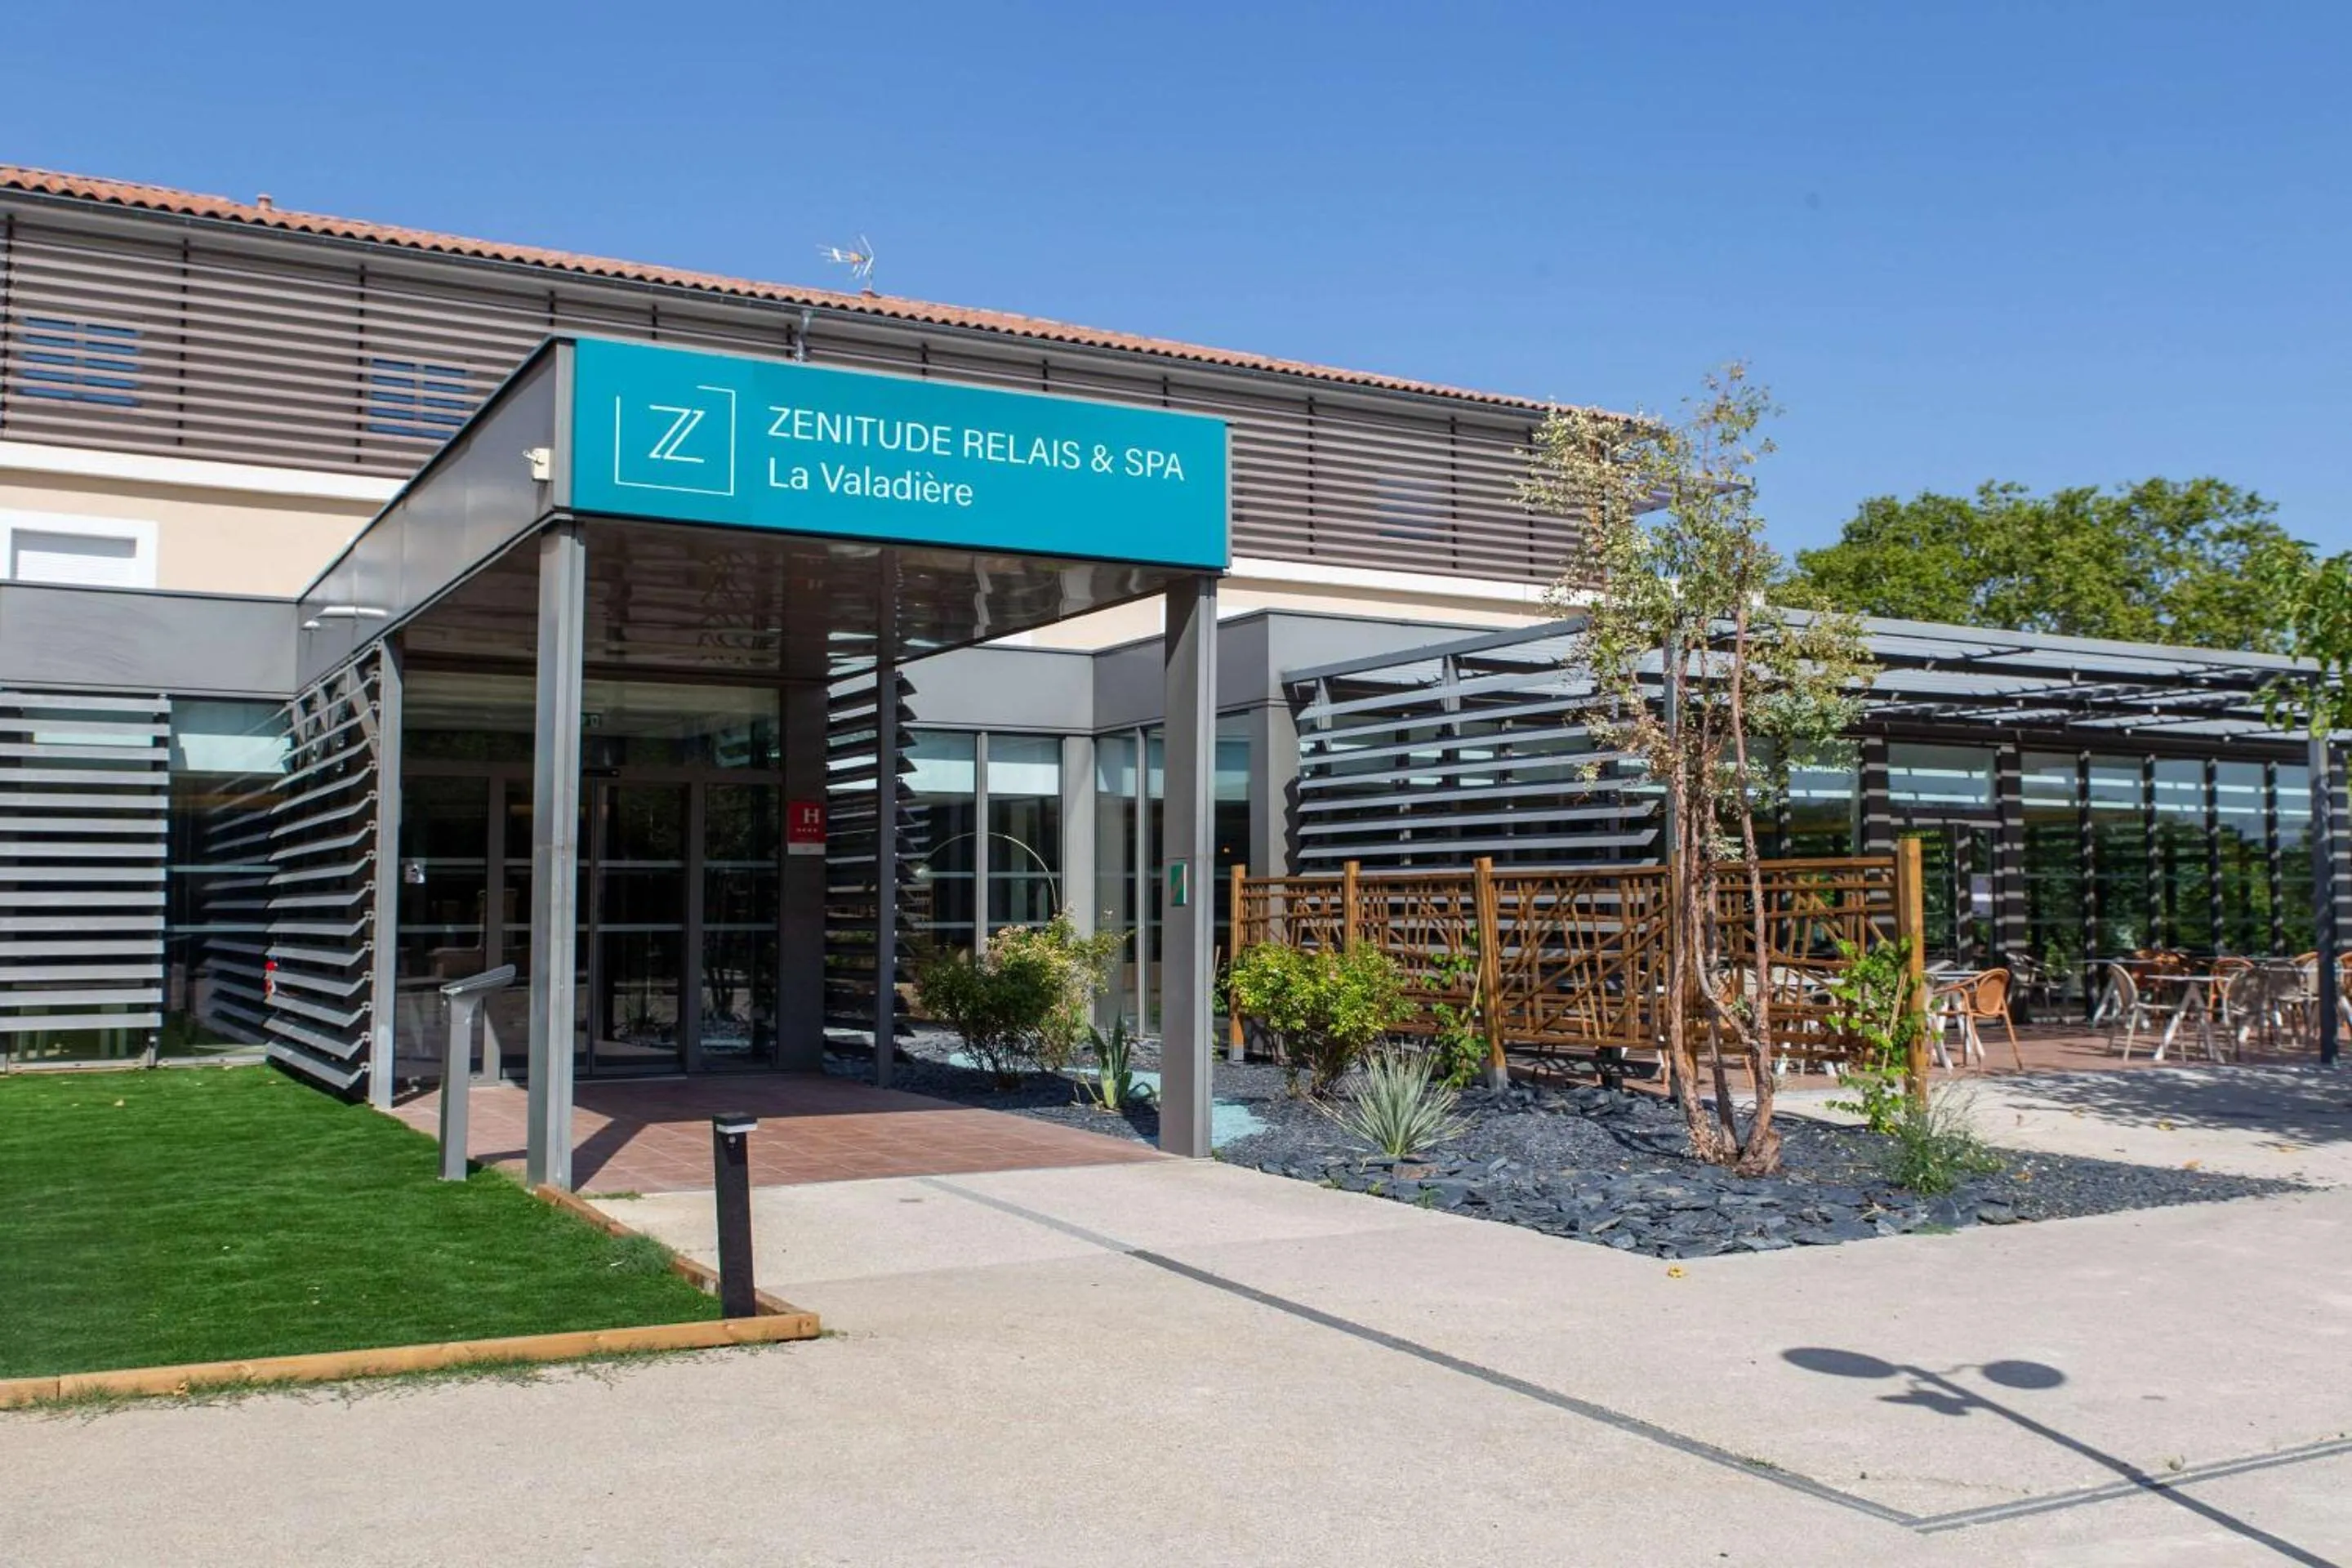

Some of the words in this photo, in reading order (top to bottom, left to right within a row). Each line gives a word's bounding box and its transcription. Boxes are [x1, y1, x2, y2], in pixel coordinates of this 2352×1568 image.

[768, 406, 951, 456] ZENITUDE
[963, 428, 1081, 470] RELAIS
[1090, 443, 1114, 473] &
[1125, 448, 1184, 481] SPA
[768, 457, 809, 490] La
[821, 462, 973, 506] Valadière
[804, 808, 820, 824] H
